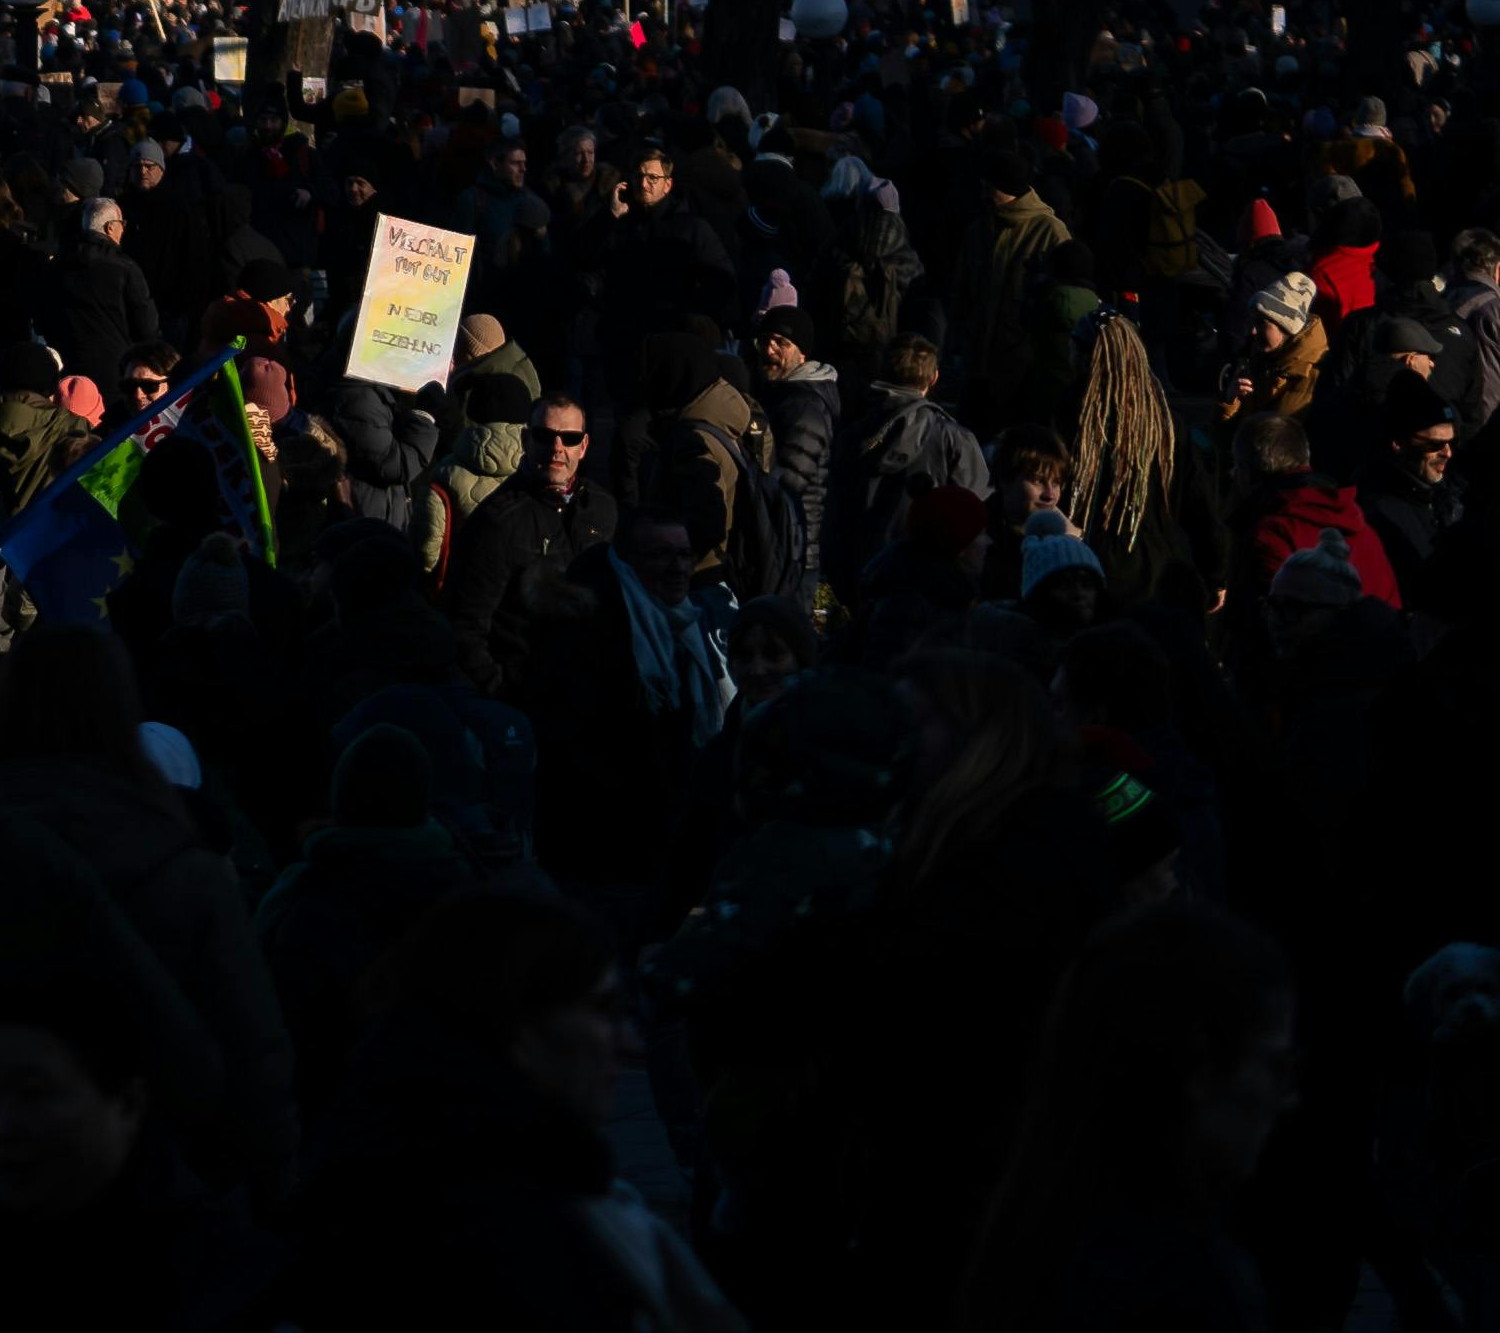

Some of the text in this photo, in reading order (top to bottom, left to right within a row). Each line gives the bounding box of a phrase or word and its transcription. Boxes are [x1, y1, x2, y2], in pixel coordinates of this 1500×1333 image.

[389, 226, 468, 265] VIELFALT
[395, 256, 451, 286] TUT GUT
[387, 303, 402, 317] IN
